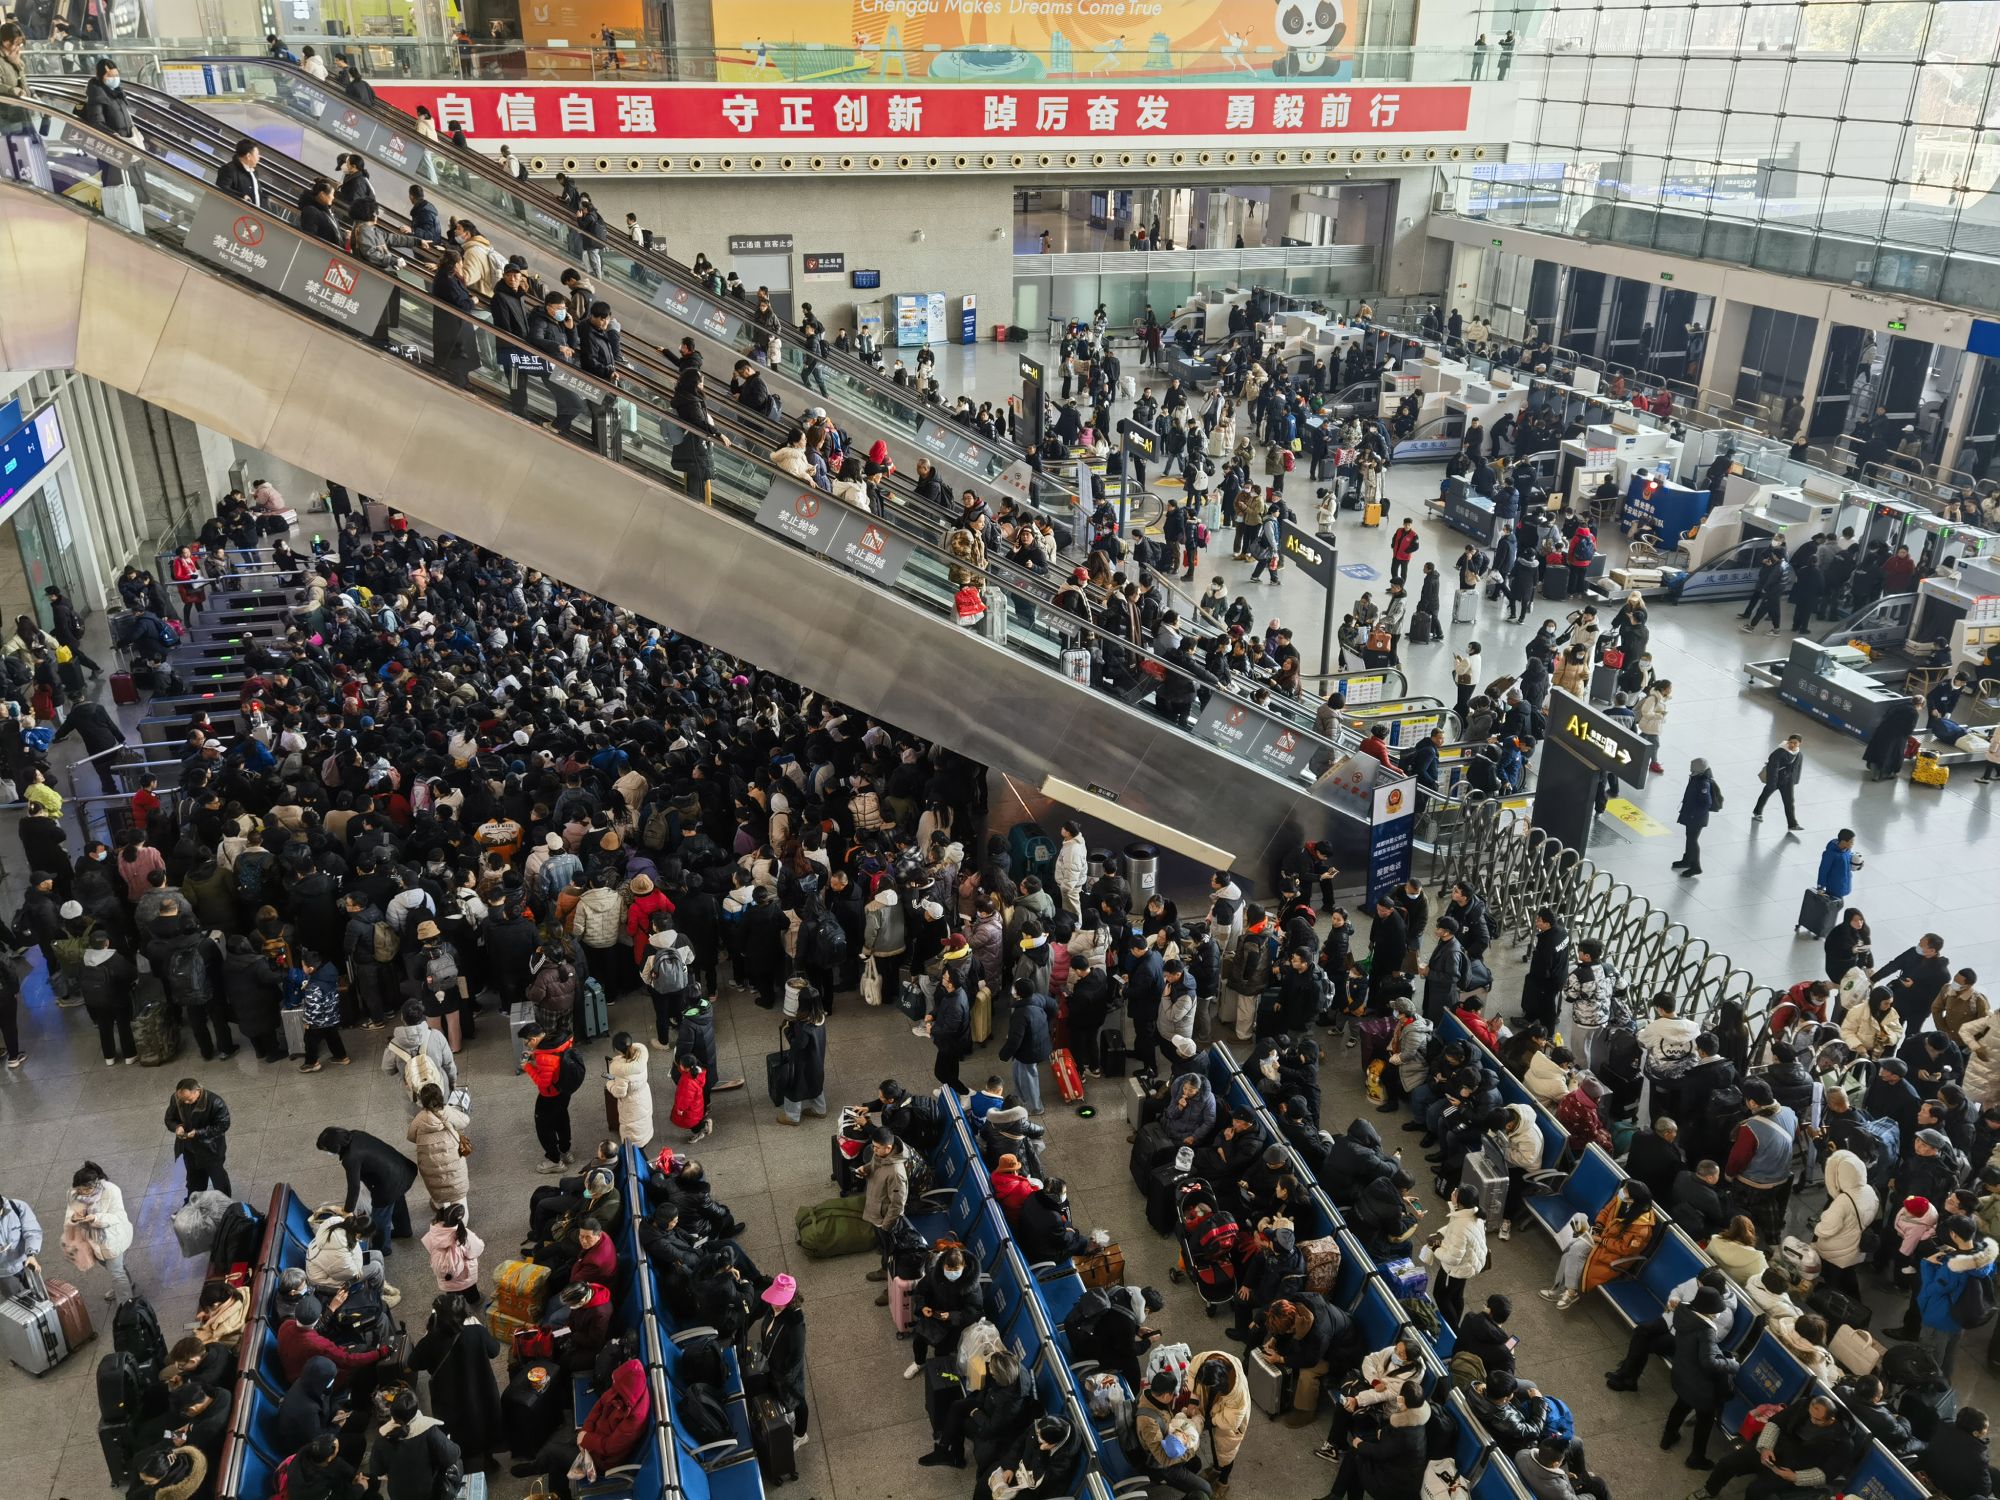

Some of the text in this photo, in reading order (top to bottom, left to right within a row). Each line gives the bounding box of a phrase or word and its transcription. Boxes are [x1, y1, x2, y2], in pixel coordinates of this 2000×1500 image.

[861, 0, 1162, 17] Chengdu Makes Dreams Come True
[436, 92, 1400, 133] 自信自强 守正创新 踔厉奋发 勇毅前行
[212, 233, 268, 269] 禁止抛物
[218, 251, 253, 273] No Tossing
[304, 279, 360, 315] 禁止翻越
[308, 295, 348, 320] No Crossing
[778, 509, 819, 536] 禁止抛物
[845, 543, 886, 569] 禁止翻越
[1286, 535, 1299, 553] A1
[1211, 719, 1244, 741] 禁止抛物
[1566, 714, 1588, 740] A1
[1262, 744, 1296, 765] 禁止翻越
